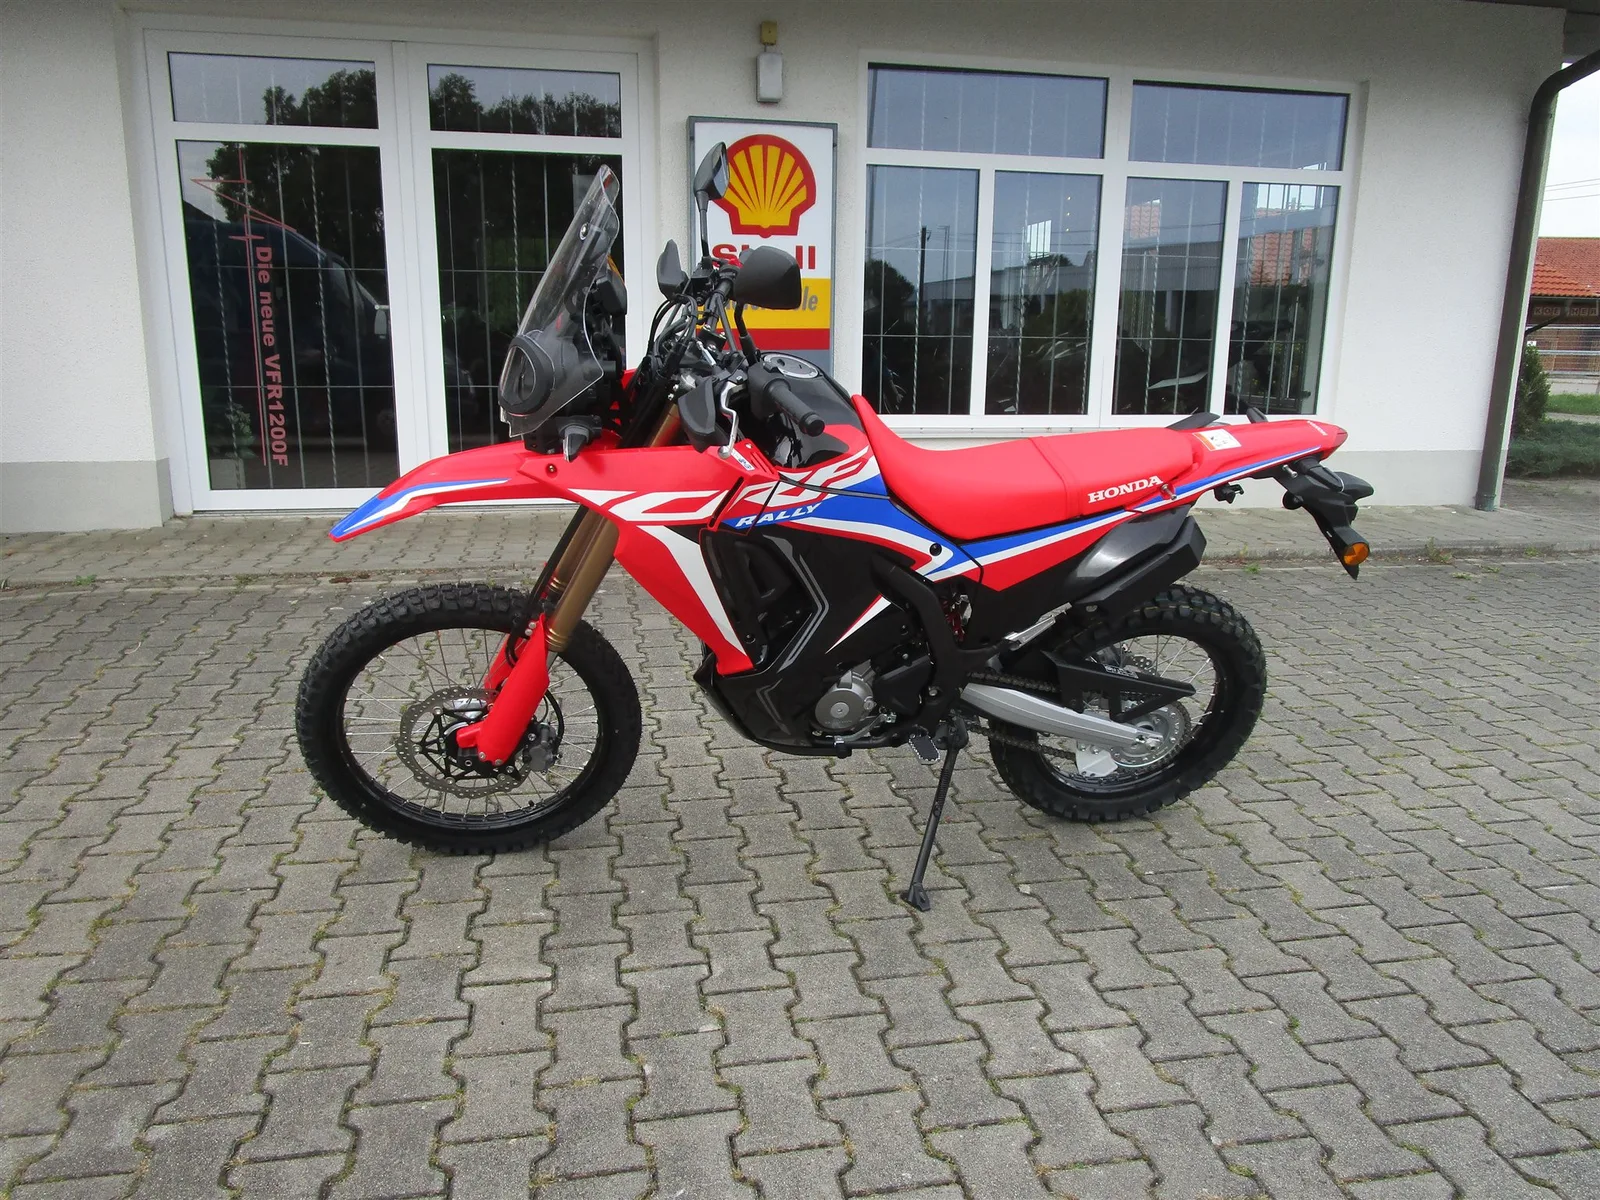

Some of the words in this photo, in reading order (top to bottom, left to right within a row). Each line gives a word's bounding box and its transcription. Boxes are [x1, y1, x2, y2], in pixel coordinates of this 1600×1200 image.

[256, 247, 273, 283] Die
[712, 244, 816, 269] Sll
[260, 291, 275, 347] neue
[264, 353, 288, 466] VFR1200F
[1088, 475, 1164, 504] HONDA
[736, 502, 822, 527] RALLY
